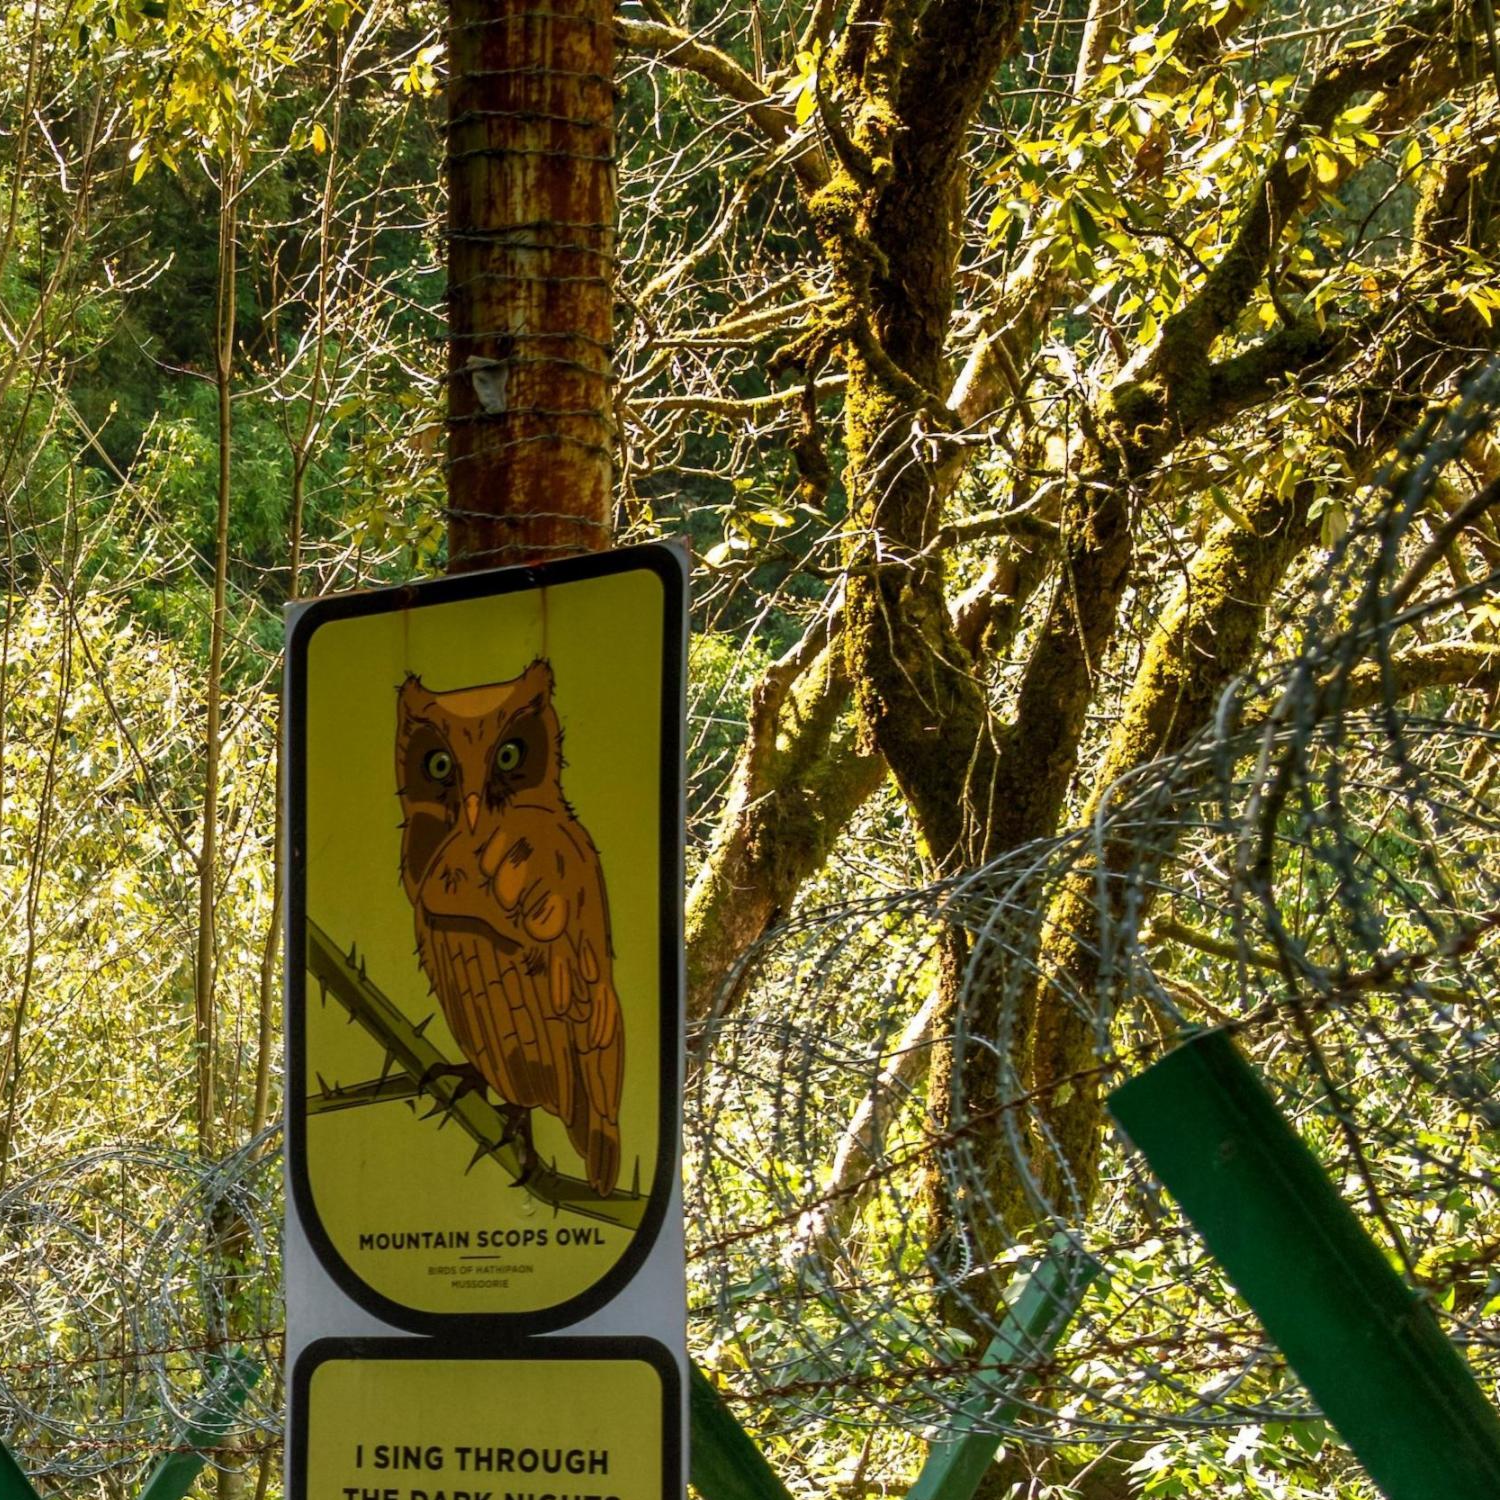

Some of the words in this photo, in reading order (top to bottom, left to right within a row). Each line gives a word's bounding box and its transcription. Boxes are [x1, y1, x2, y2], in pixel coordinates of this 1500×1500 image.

[359, 1231, 470, 1251] MOUNTAIN
[477, 1228, 548, 1249] SCOPS
[556, 1227, 606, 1247] OWL
[427, 1265, 457, 1276] BIRDS
[459, 1265, 473, 1275] OF
[451, 1279, 510, 1289] MUSSOORIE
[356, 1444, 363, 1469] I
[373, 1444, 444, 1472] SING
[454, 1446, 608, 1476] THROUGH
